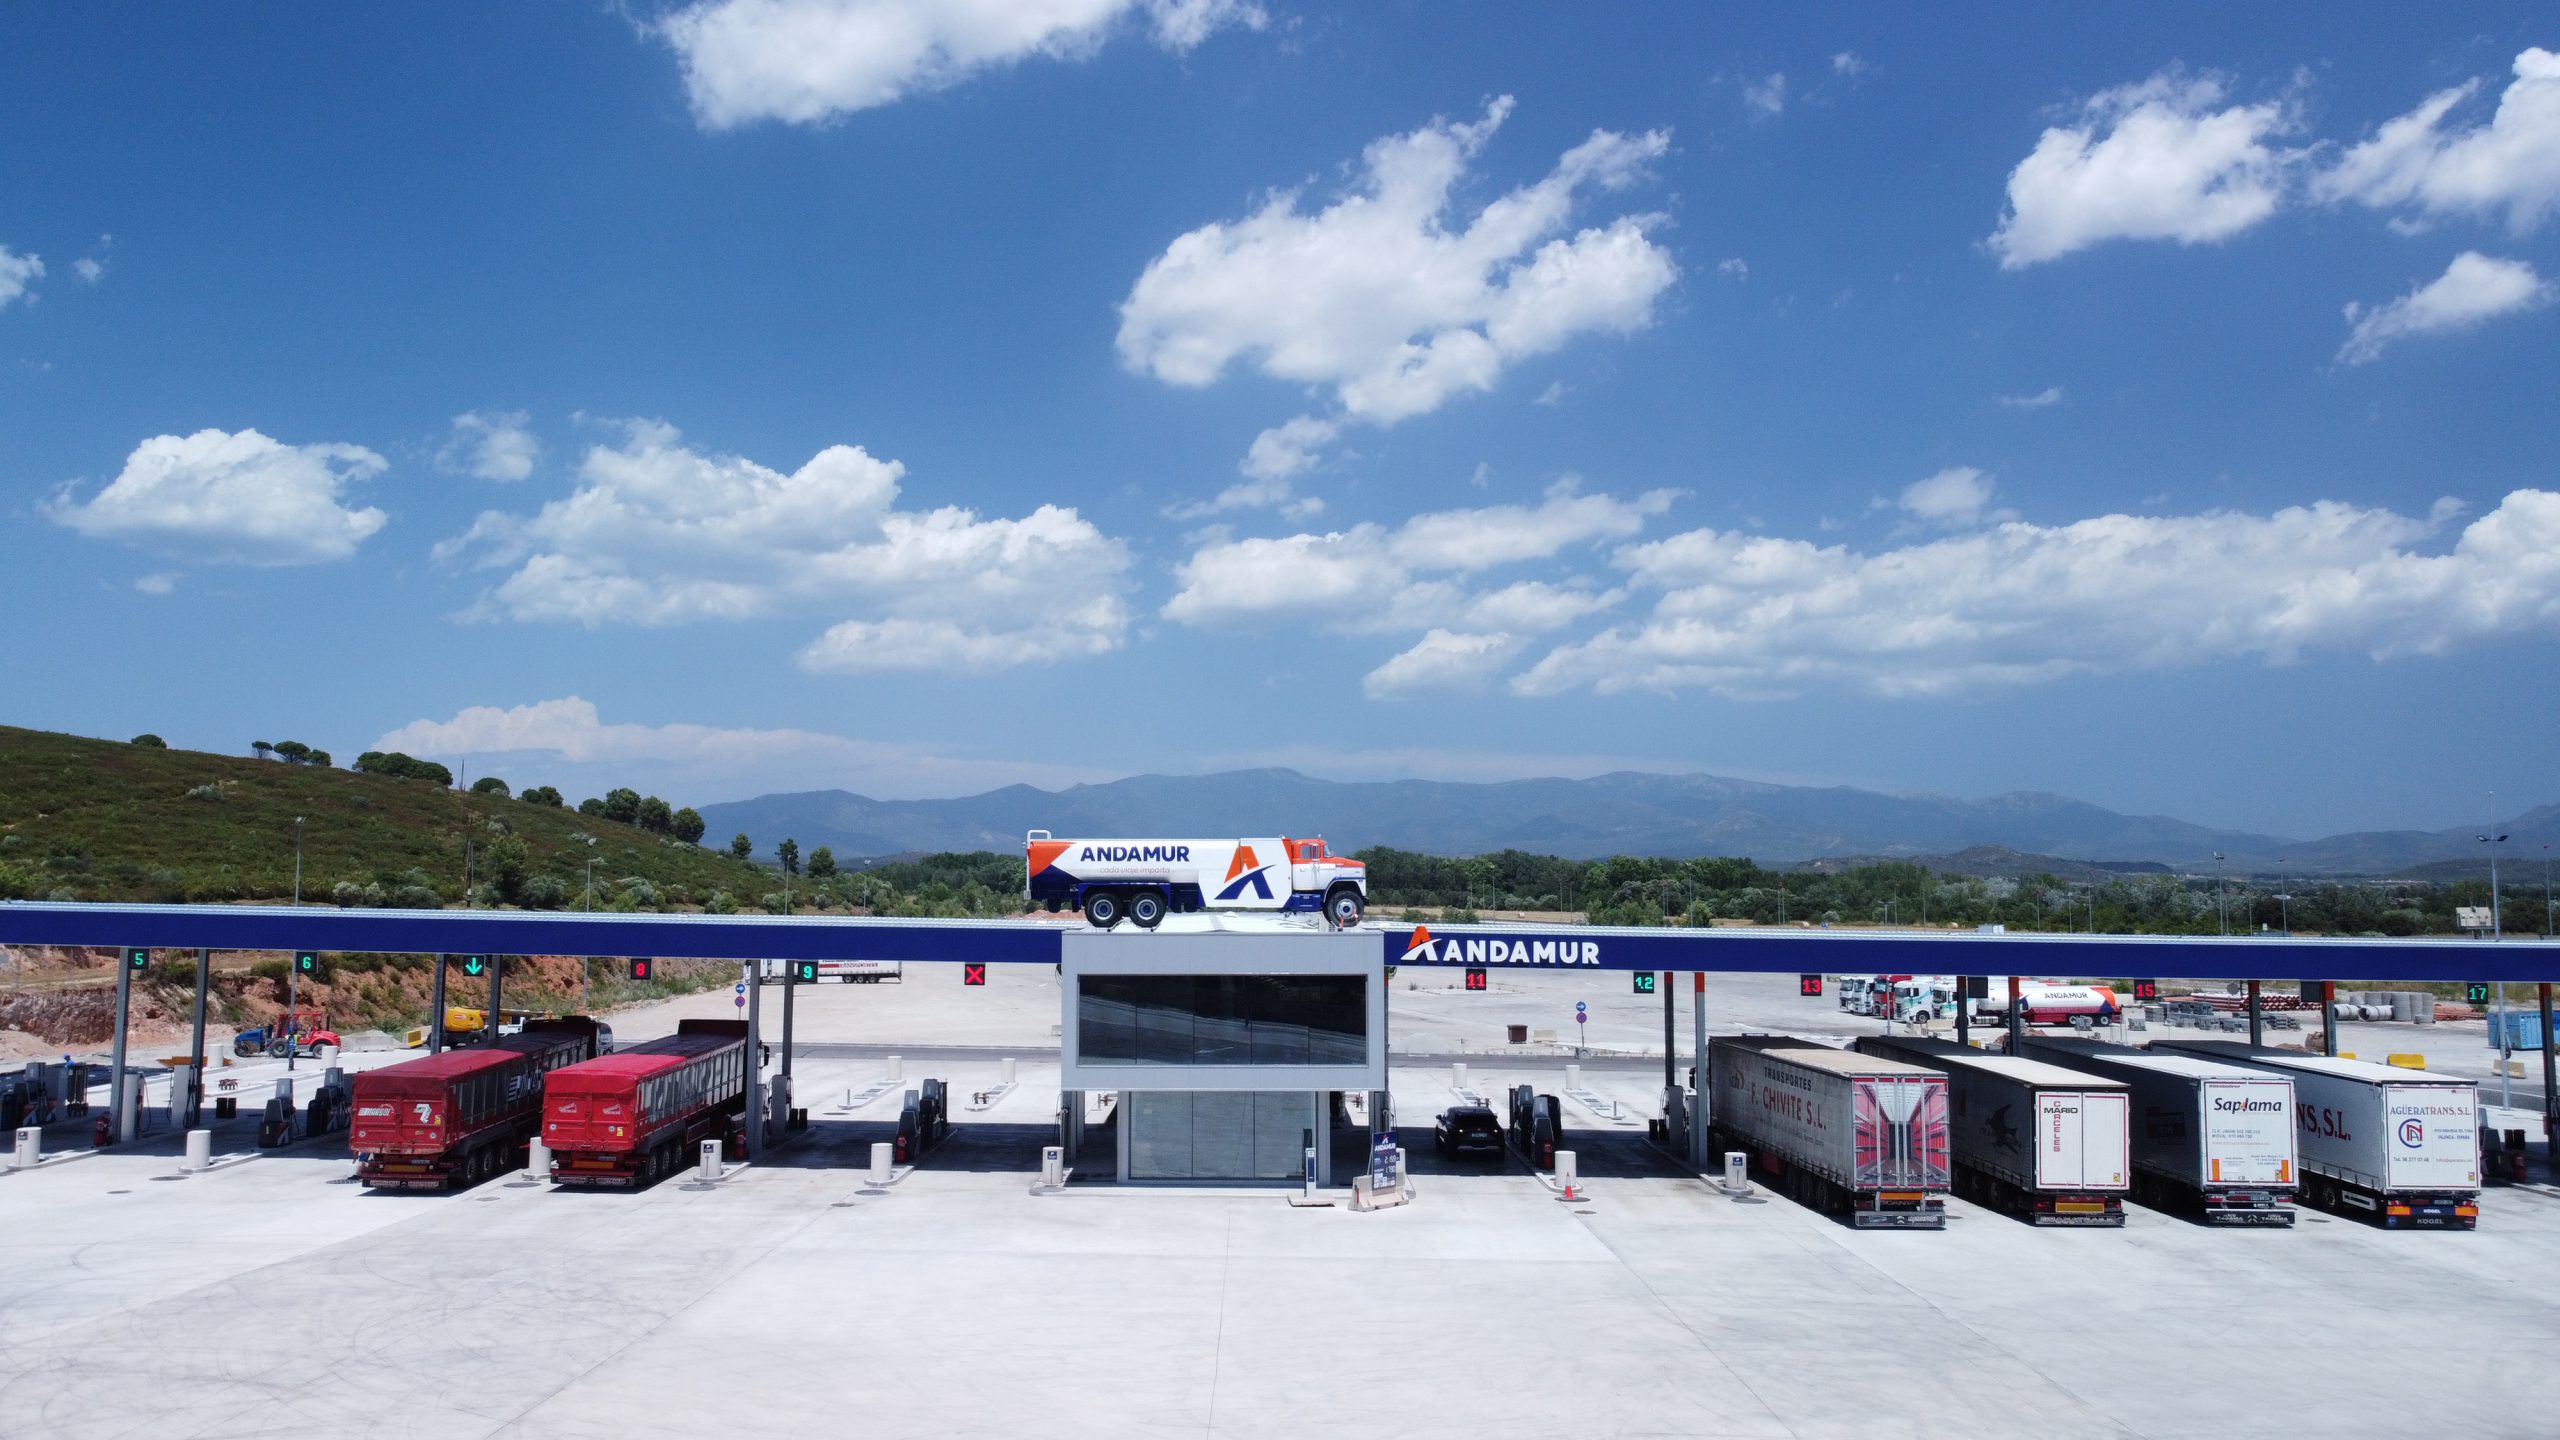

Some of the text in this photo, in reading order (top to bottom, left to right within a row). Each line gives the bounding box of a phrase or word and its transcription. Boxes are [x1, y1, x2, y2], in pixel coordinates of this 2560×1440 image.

[1080, 846, 1190, 862] ANDAMUR
[1140, 866, 1170, 875] importa
[135, 952, 144, 966] 5
[1443, 939, 1600, 965] ANDAMUR
[302, 956, 312, 969] 6
[803, 965, 813, 979] 9
[1467, 973, 1486, 989] 11
[1802, 979, 1822, 993] 13
[2136, 983, 2155, 997] 15
[2469, 987, 2487, 1000] 17
[1764, 1066, 1812, 1092] TRANSPORTES
[1763, 1086, 1802, 1121] CHIVITE
[1806, 1100, 1827, 1131] S.L.
[2323, 1108, 2351, 1141] S.L.
